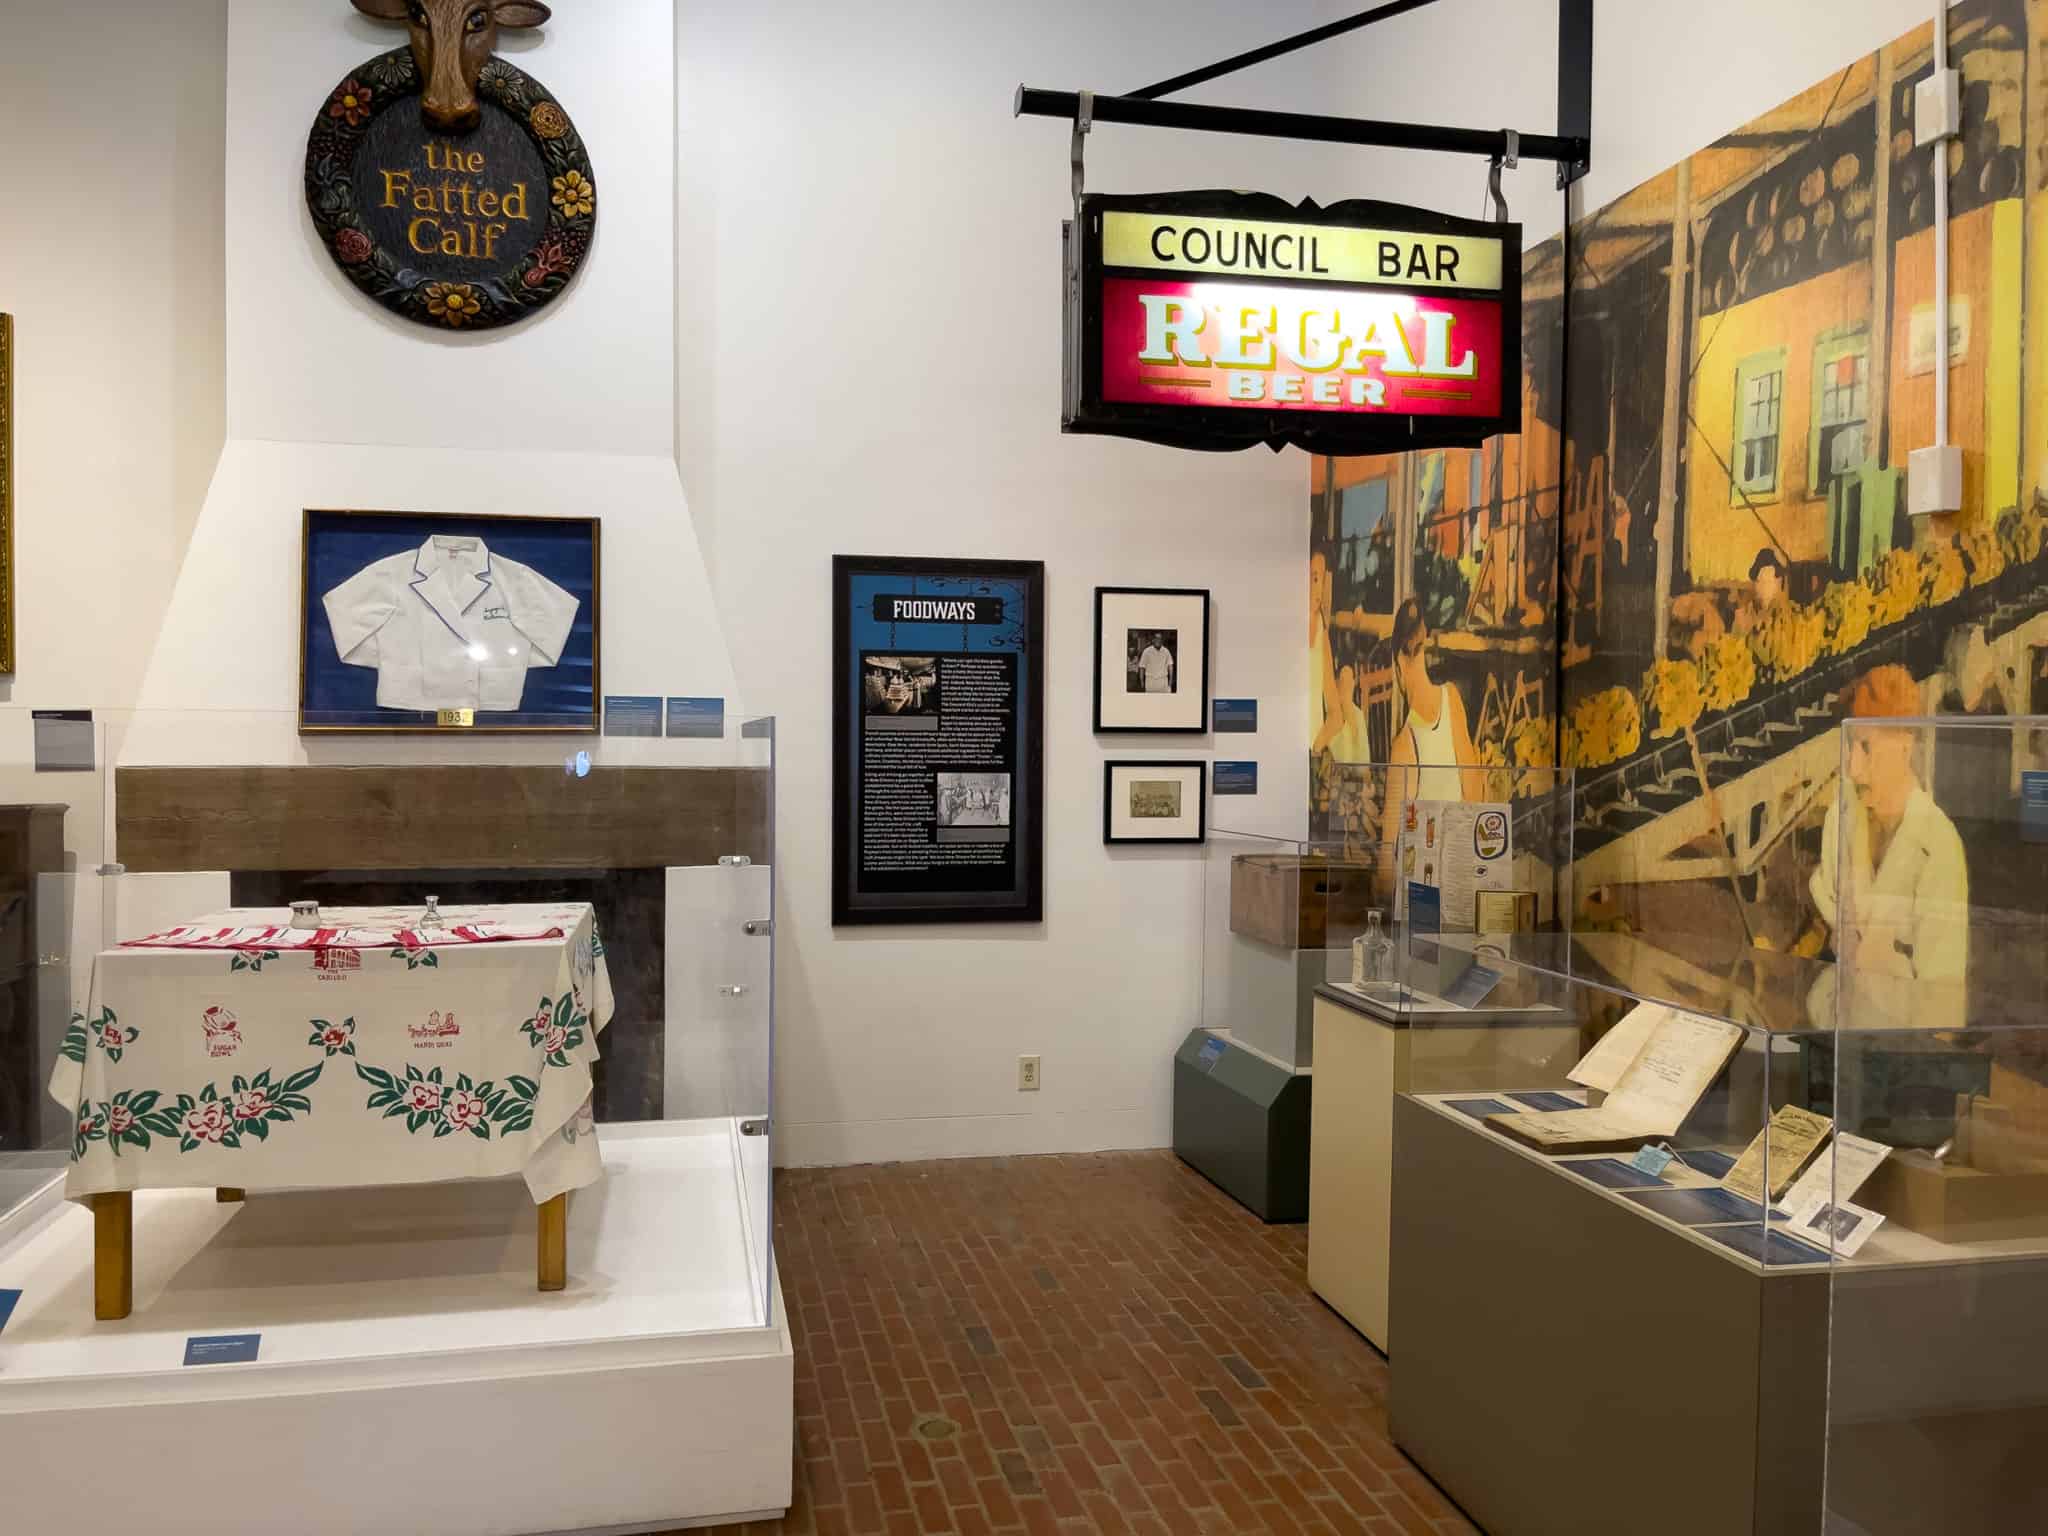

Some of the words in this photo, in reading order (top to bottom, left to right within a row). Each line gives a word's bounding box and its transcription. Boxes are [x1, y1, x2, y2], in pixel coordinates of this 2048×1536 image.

[422, 140, 486, 173] the
[379, 169, 529, 220] Fatted
[408, 216, 507, 259] Calf
[1151, 225, 1329, 274] COUNCIL
[1377, 241, 1461, 282] BAR
[1138, 294, 1479, 379] REGAL
[1228, 371, 1387, 406] BEER
[893, 600, 976, 620] FOODWAYS
